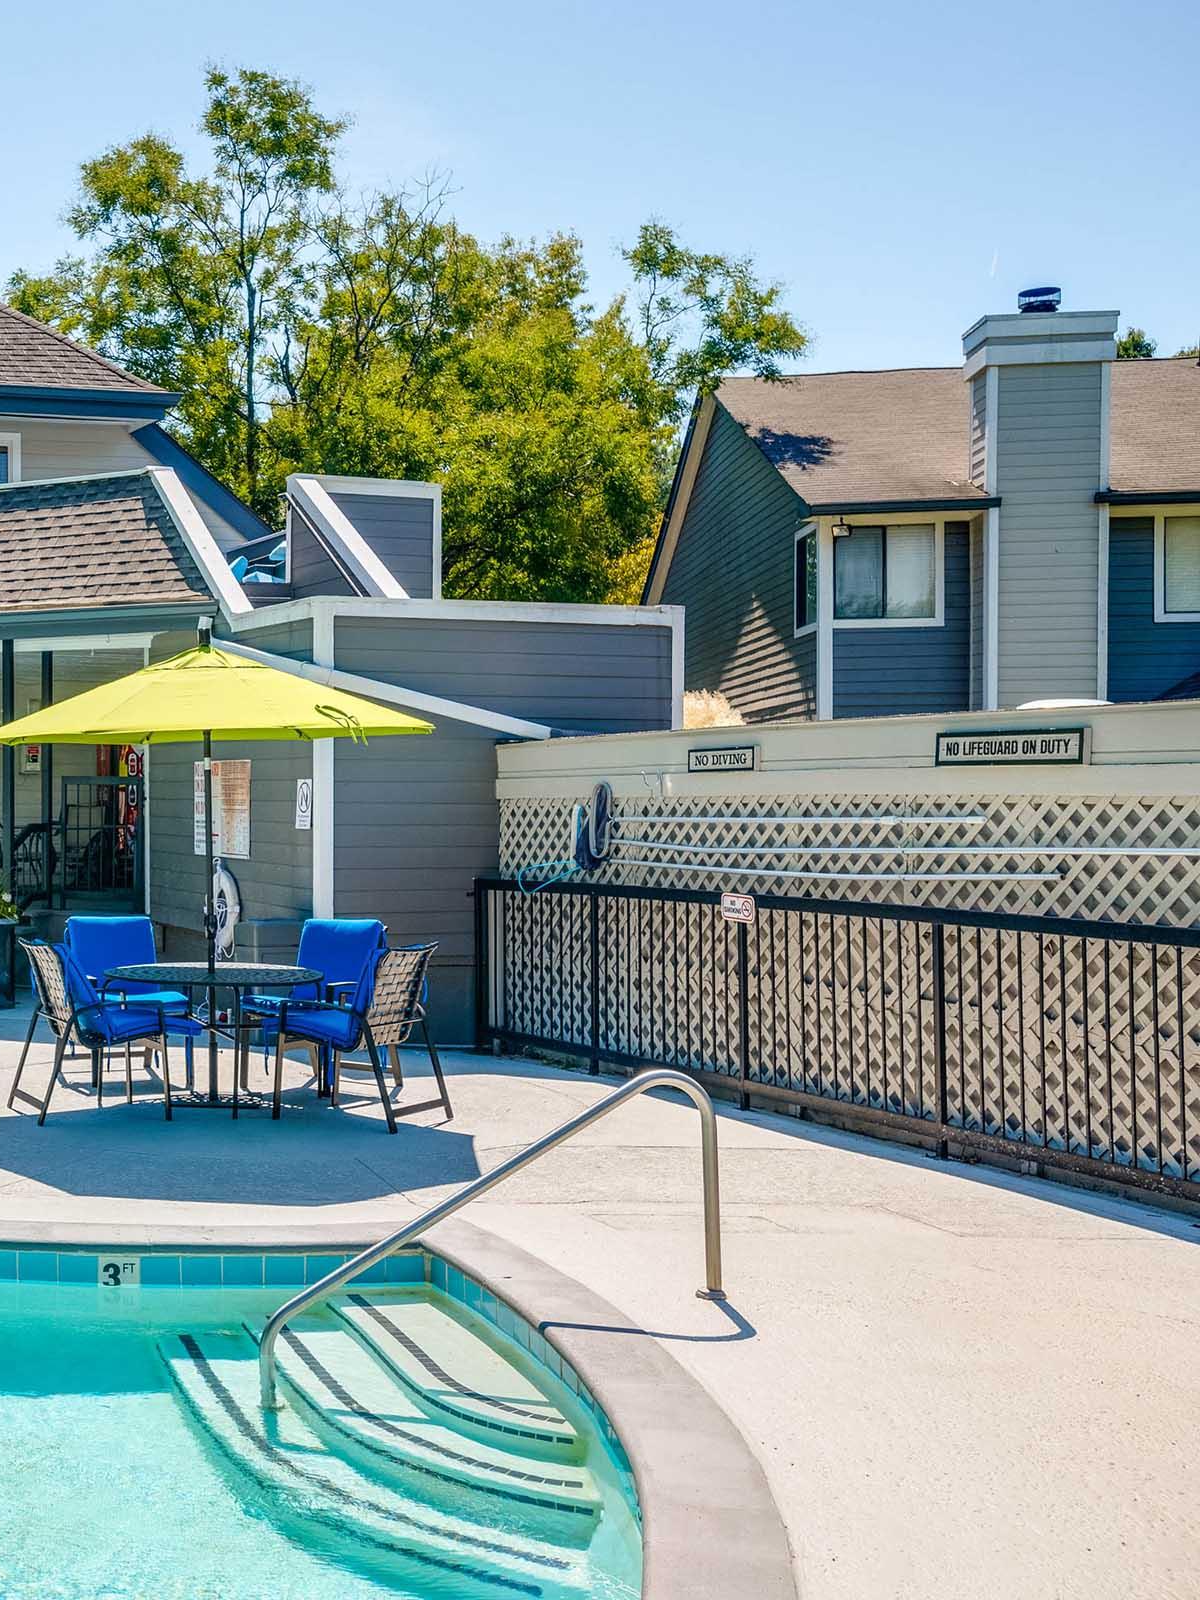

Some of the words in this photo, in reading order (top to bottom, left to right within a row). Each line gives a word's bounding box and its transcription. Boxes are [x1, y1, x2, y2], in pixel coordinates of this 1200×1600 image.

[945, 742, 959, 756] NO
[962, 740, 1018, 755] LIFEGUARD
[1022, 740, 1036, 754] ON
[1040, 739, 1070, 754] DUTY
[695, 755, 708, 766] NO
[711, 753, 747, 765] DIVING
[102, 1263, 121, 1286] 3
[122, 1263, 136, 1273] FT
